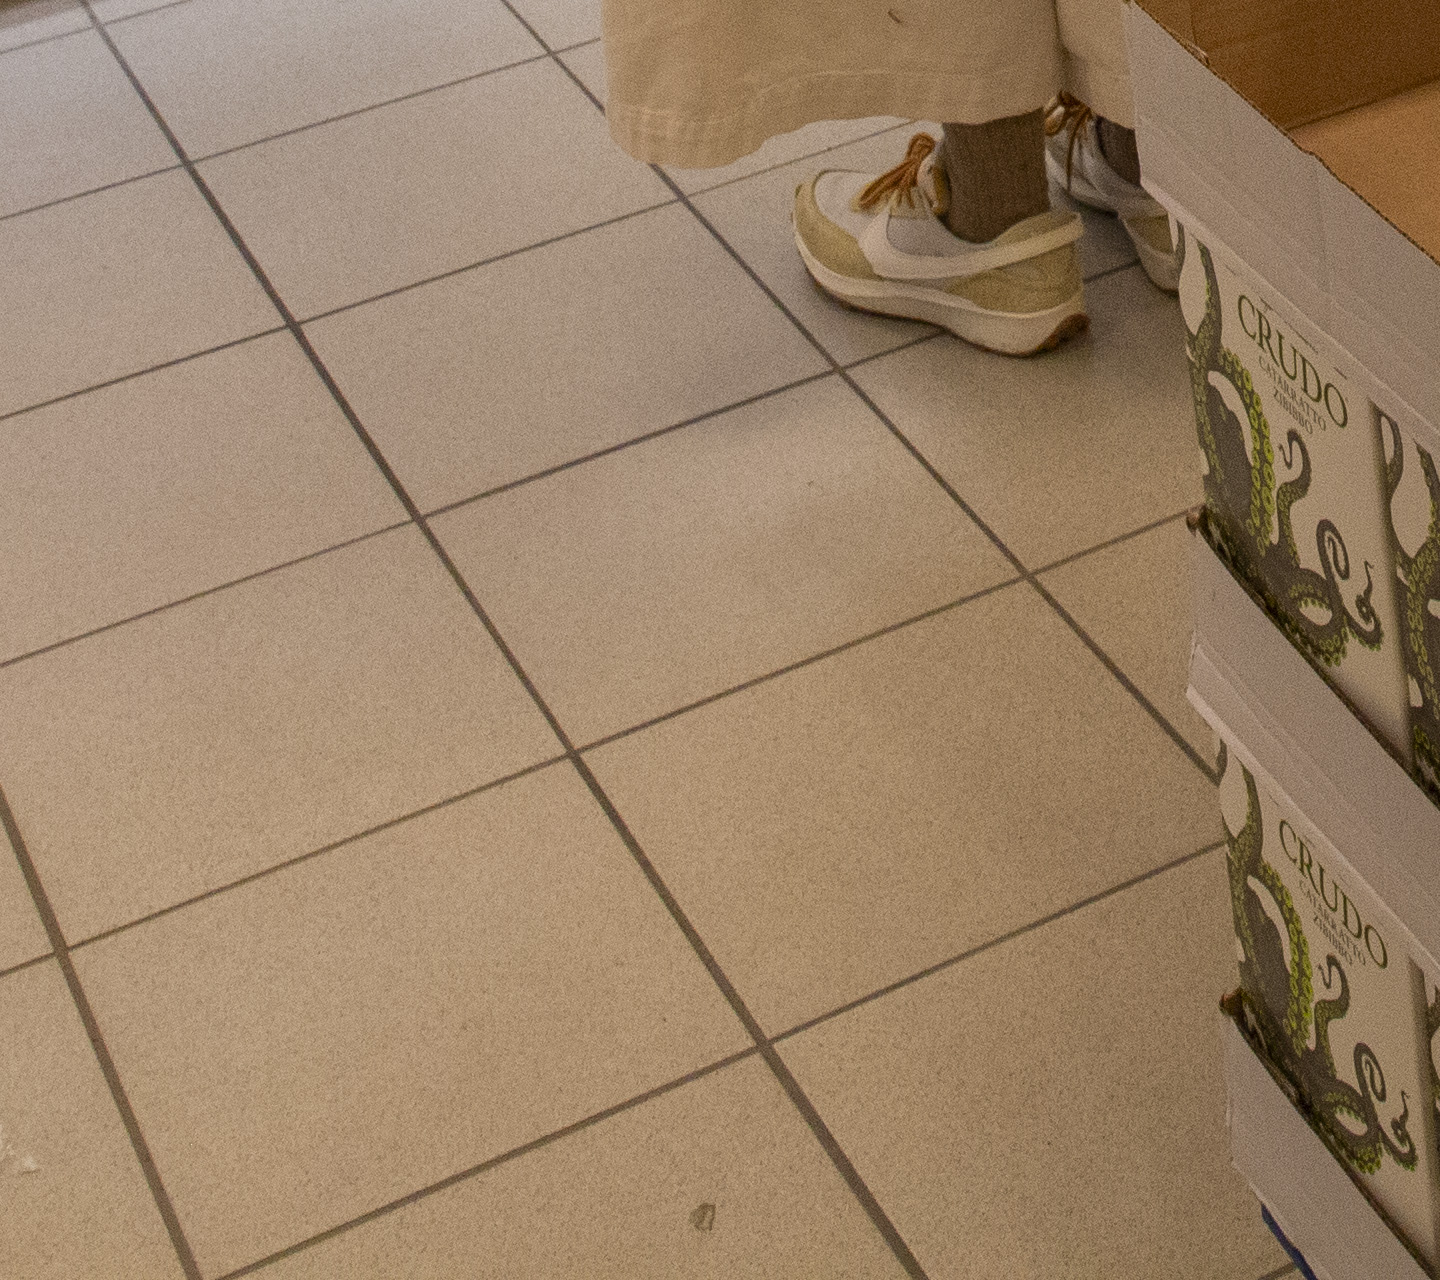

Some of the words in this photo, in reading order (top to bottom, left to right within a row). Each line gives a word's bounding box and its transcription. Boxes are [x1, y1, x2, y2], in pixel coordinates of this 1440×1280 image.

[1237, 293, 1349, 430] CRUDO
[1258, 354, 1327, 432] CATARRATTO
[1272, 385, 1314, 436] ZIBIBBO
[1278, 819, 1388, 970] CRUDO
[1298, 880, 1366, 969] CATARRATTO
[1312, 910, 1353, 967] ZIBIBBO
